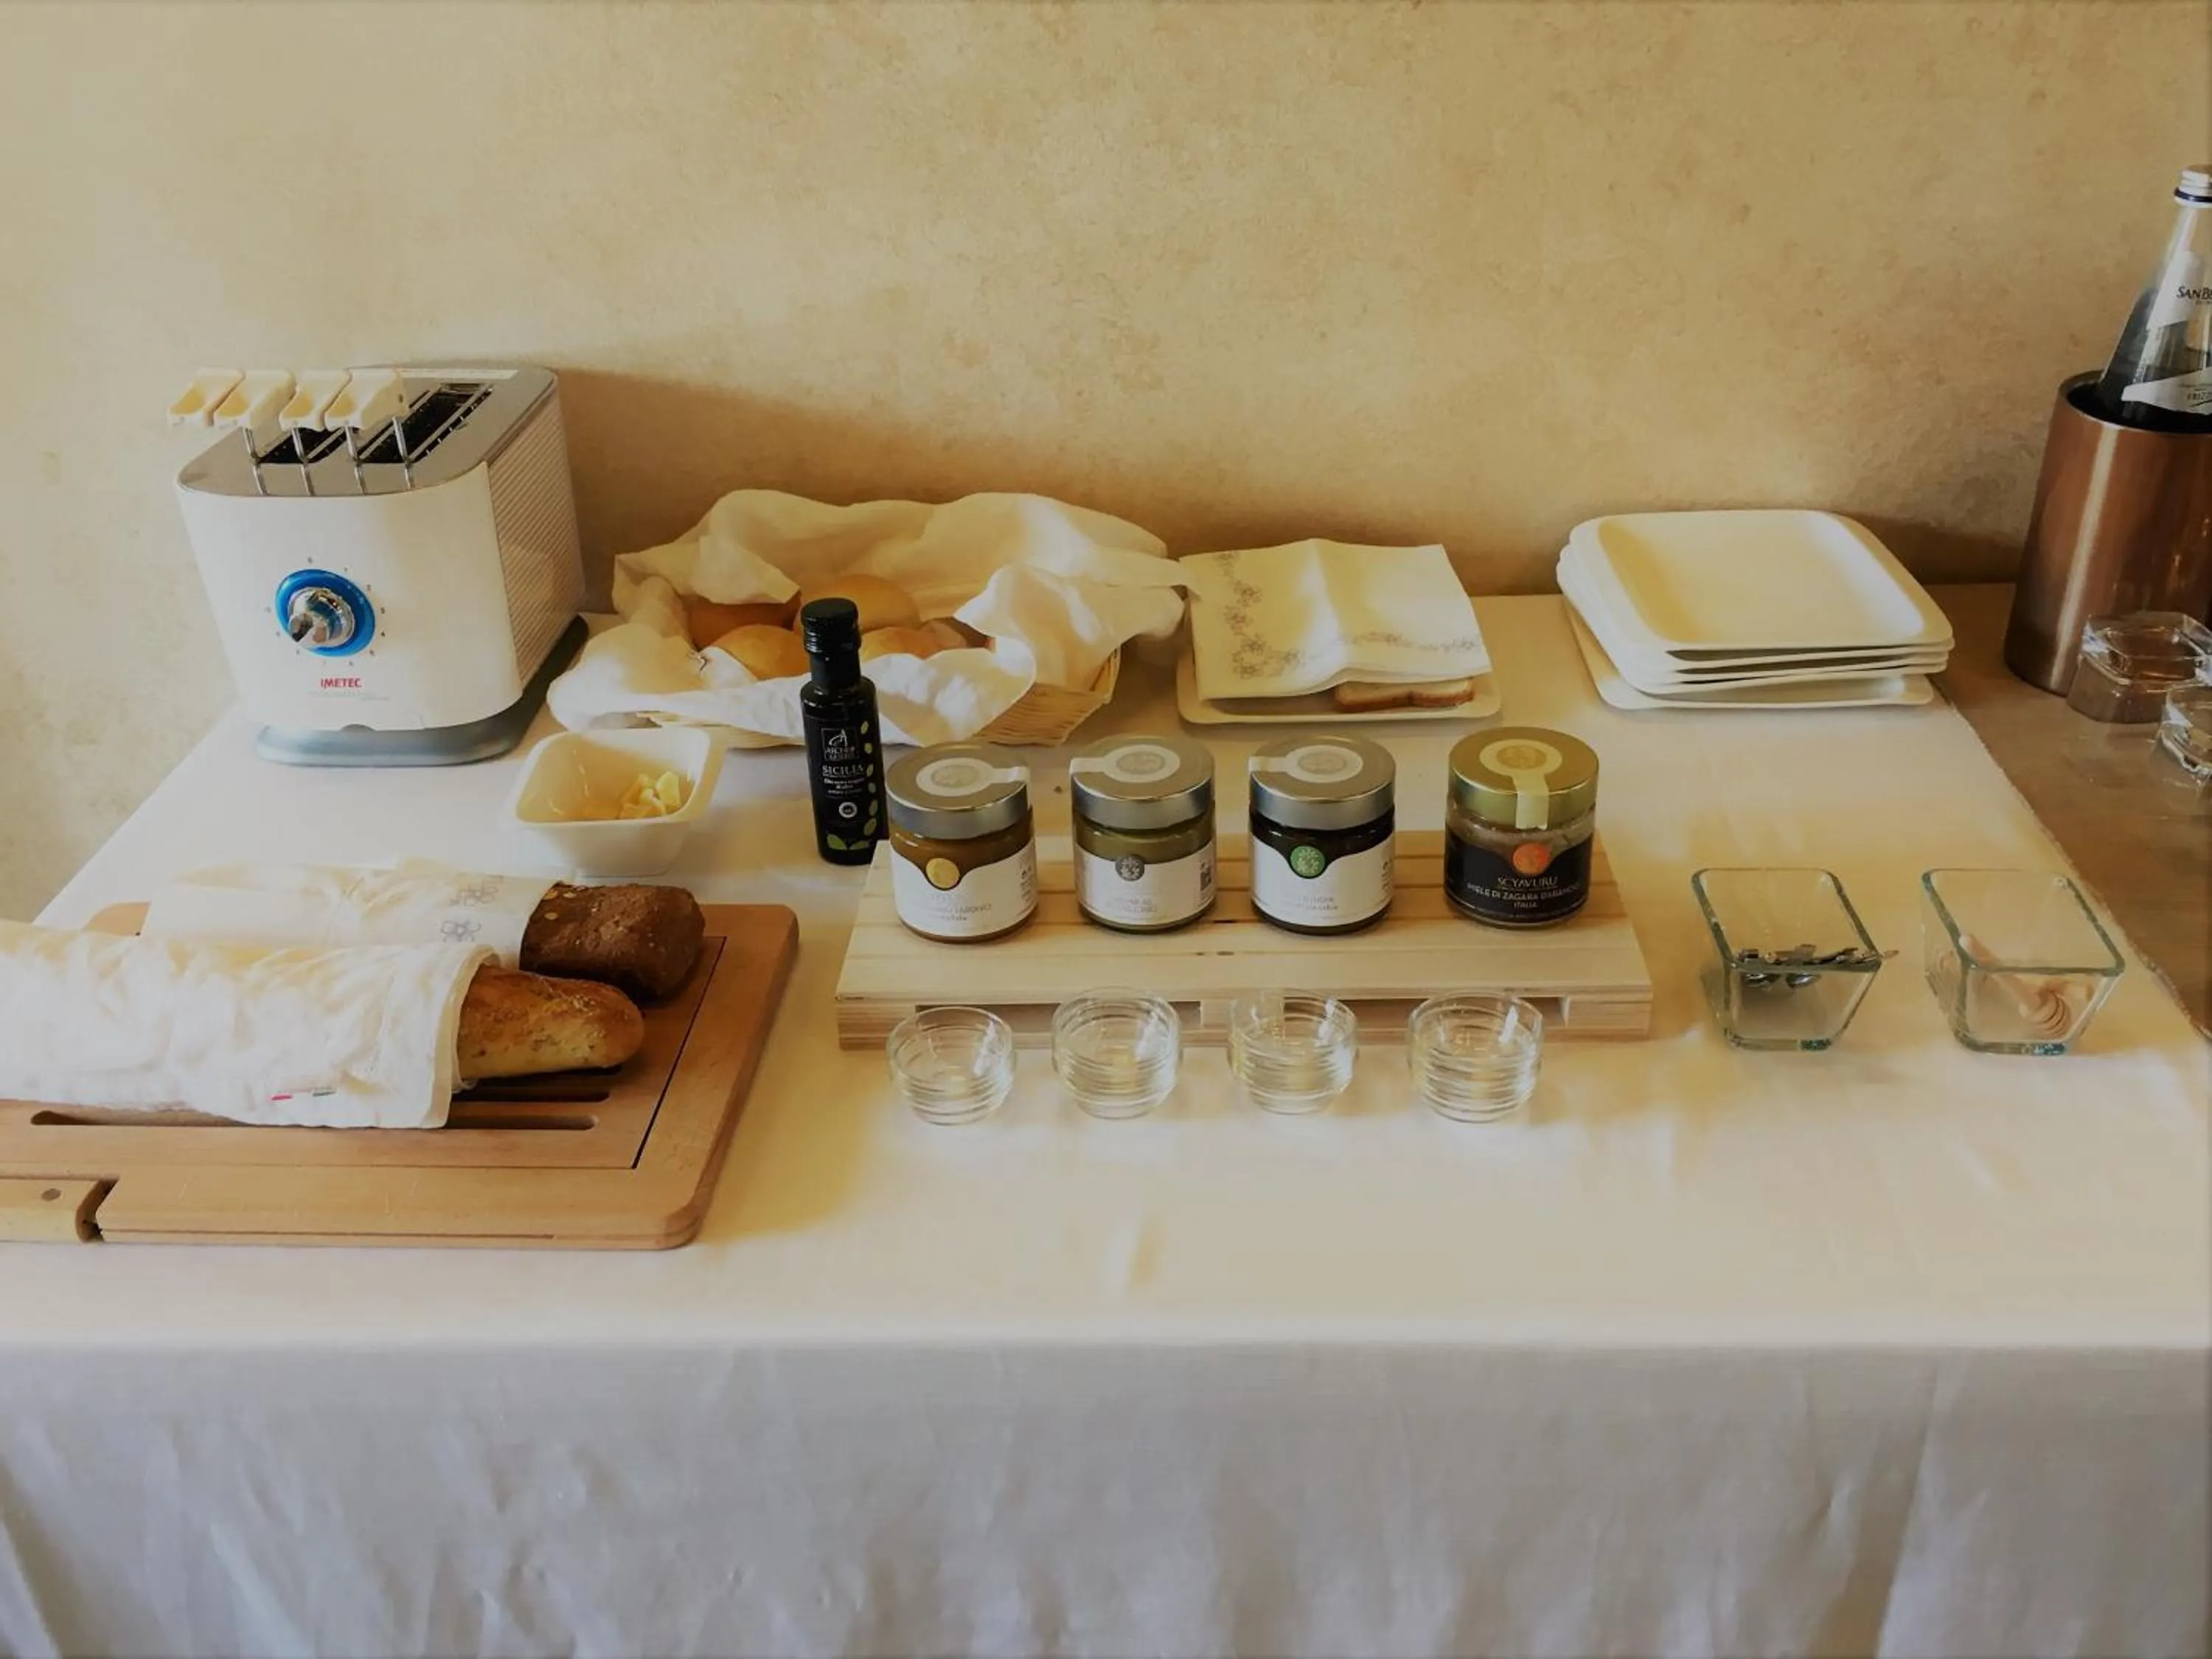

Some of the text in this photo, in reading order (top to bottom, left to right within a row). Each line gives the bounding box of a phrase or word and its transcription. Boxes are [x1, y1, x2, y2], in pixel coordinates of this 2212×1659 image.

[320, 678, 362, 689] IMETEC
[822, 765, 864, 776] SICILIA
[1492, 890, 1500, 899] DI
